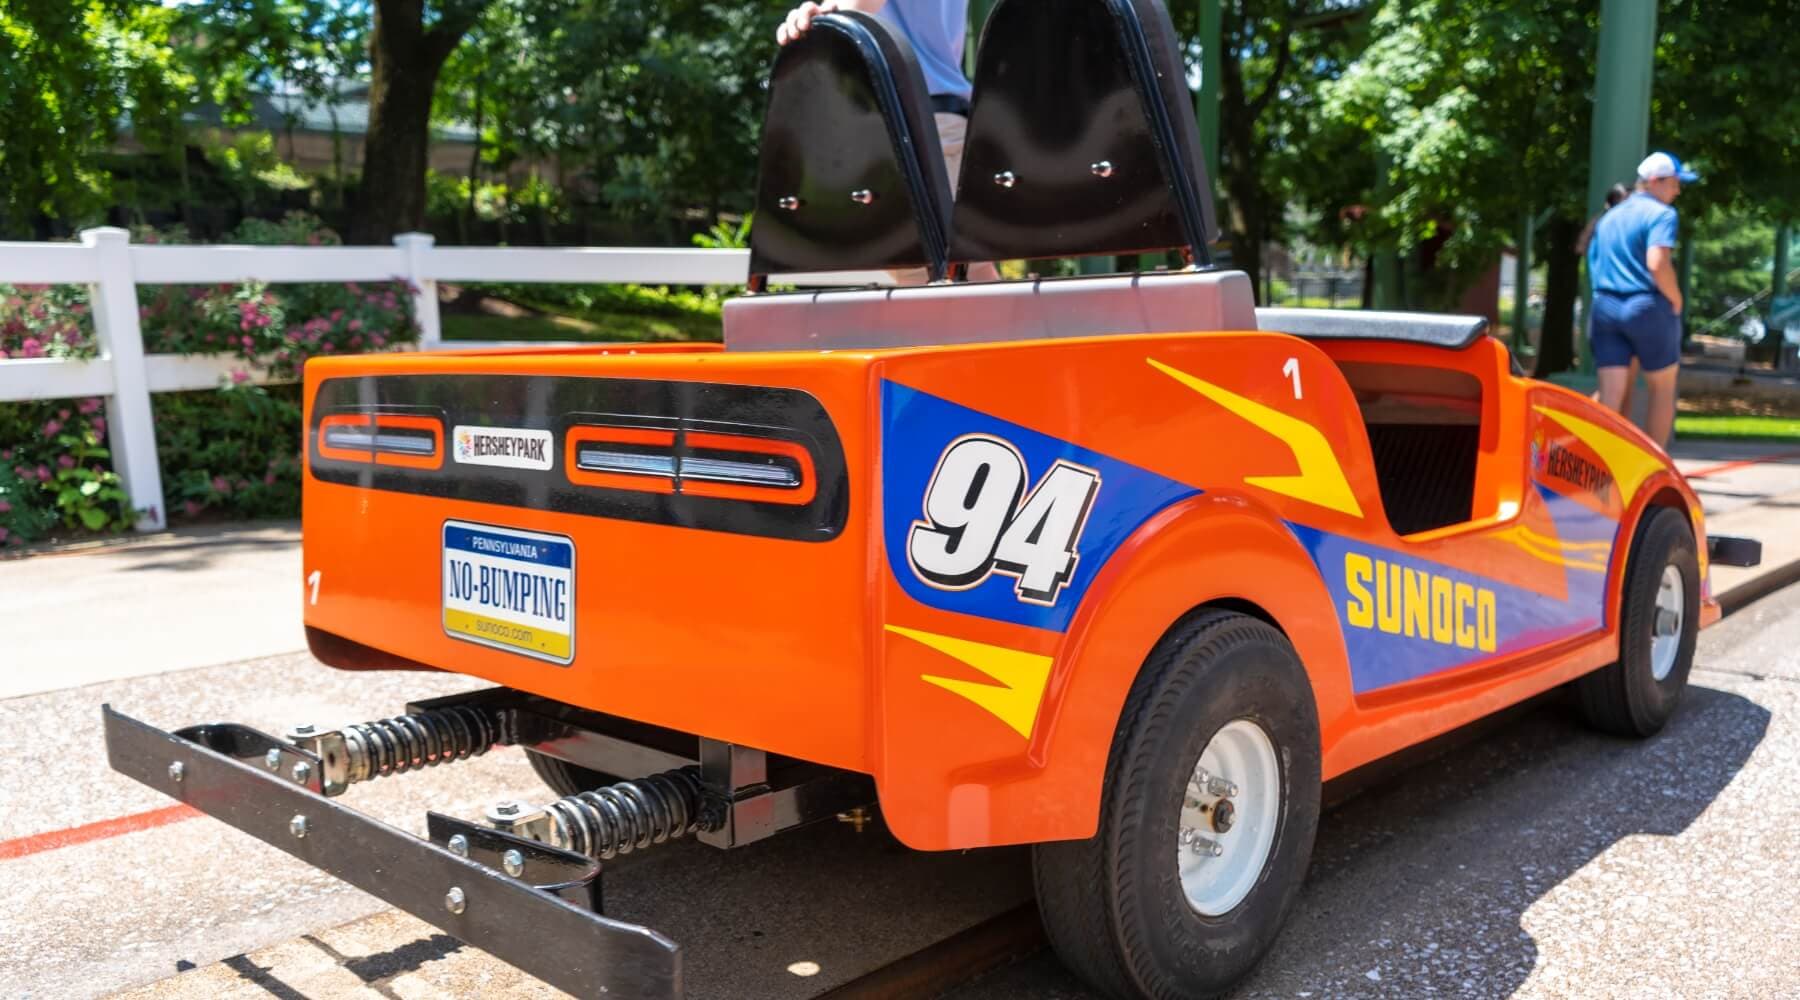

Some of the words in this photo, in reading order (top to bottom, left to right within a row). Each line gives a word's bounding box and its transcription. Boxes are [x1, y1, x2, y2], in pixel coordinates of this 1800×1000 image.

[1283, 357, 1303, 400] 1
[473, 434, 545, 462] HERSHEYPARK
[906, 433, 1101, 606] 94
[472, 536, 538, 559] PENNSYLVANIA
[308, 570, 321, 606] 1
[449, 559, 566, 622] NO-BUMPING
[1344, 551, 1497, 653] SUNOCO
[476, 619, 533, 642] sunoco.com
